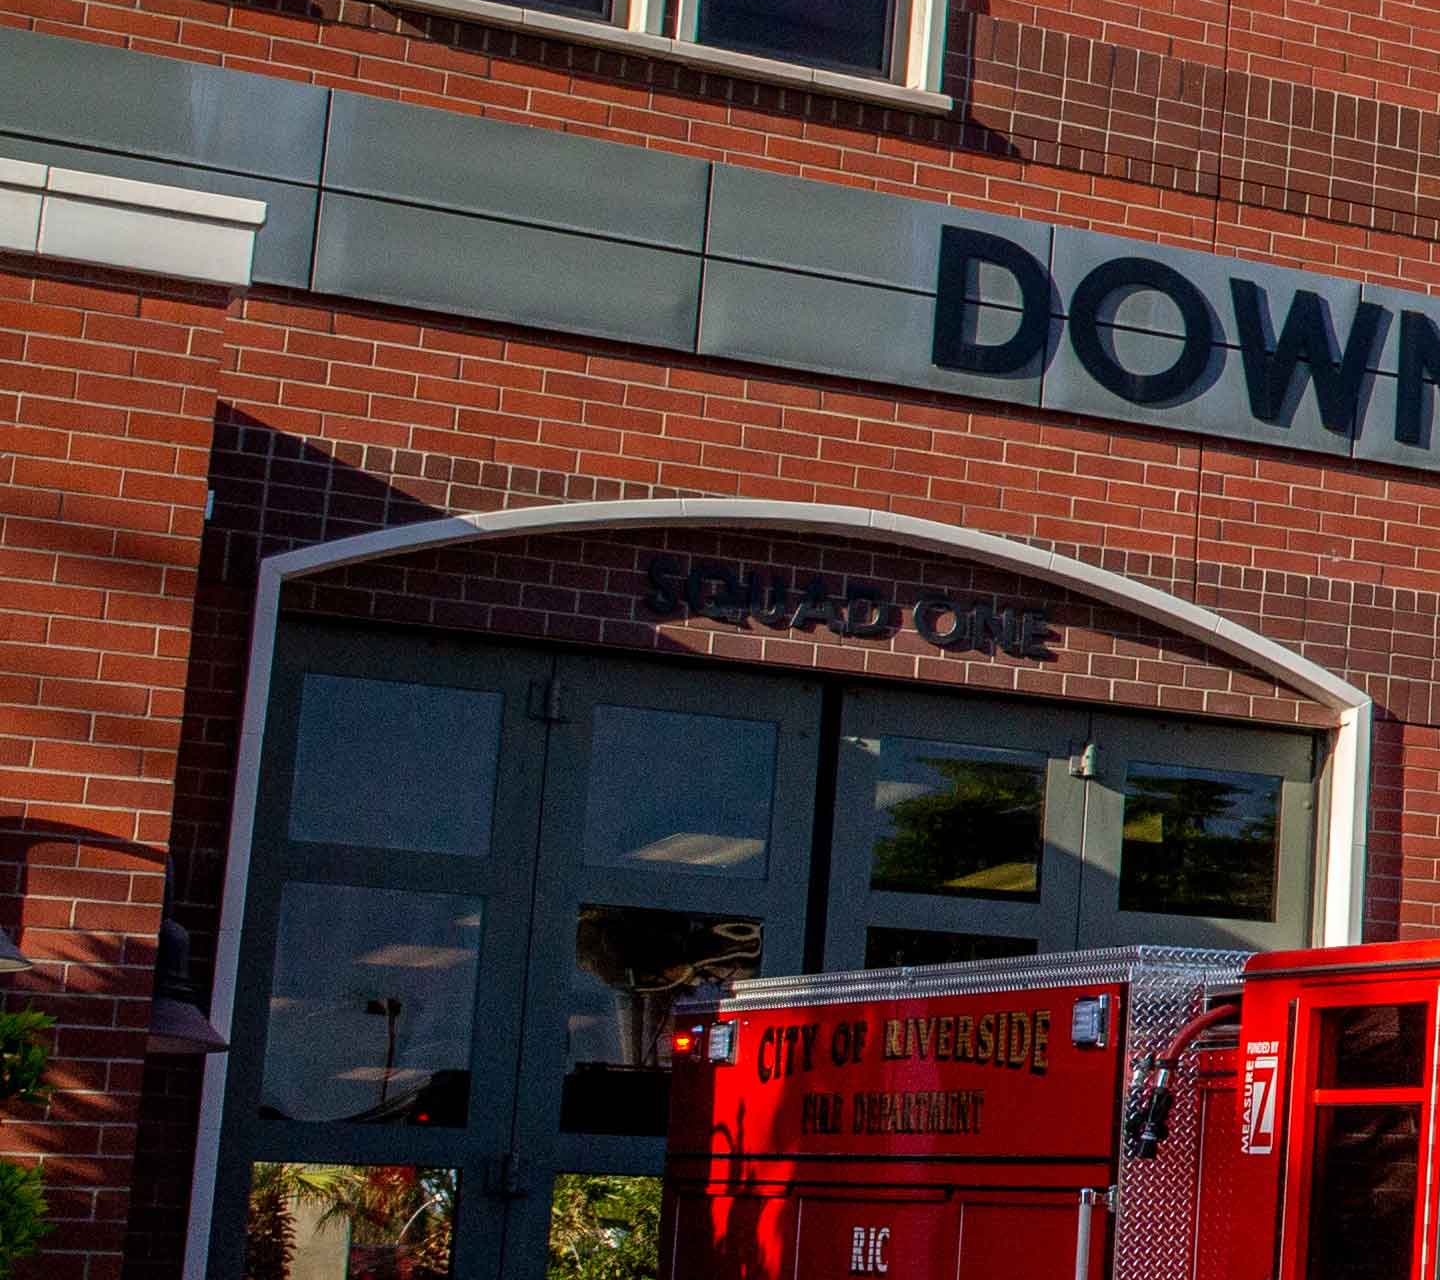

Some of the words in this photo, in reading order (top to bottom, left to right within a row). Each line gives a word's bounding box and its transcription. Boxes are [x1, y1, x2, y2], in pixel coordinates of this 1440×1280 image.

[647, 558, 899, 640] SQUAD
[912, 591, 1059, 661] ONE
[758, 1023, 816, 1084] CITY
[831, 1021, 868, 1065] OF
[884, 1009, 1051, 1075] RIVERSIDE
[801, 1090, 843, 1135] FIRE
[854, 1088, 985, 1135] DEPARTMENT
[1241, 1060, 1254, 1154] MEASURE
[851, 1226, 891, 1272] RIC
